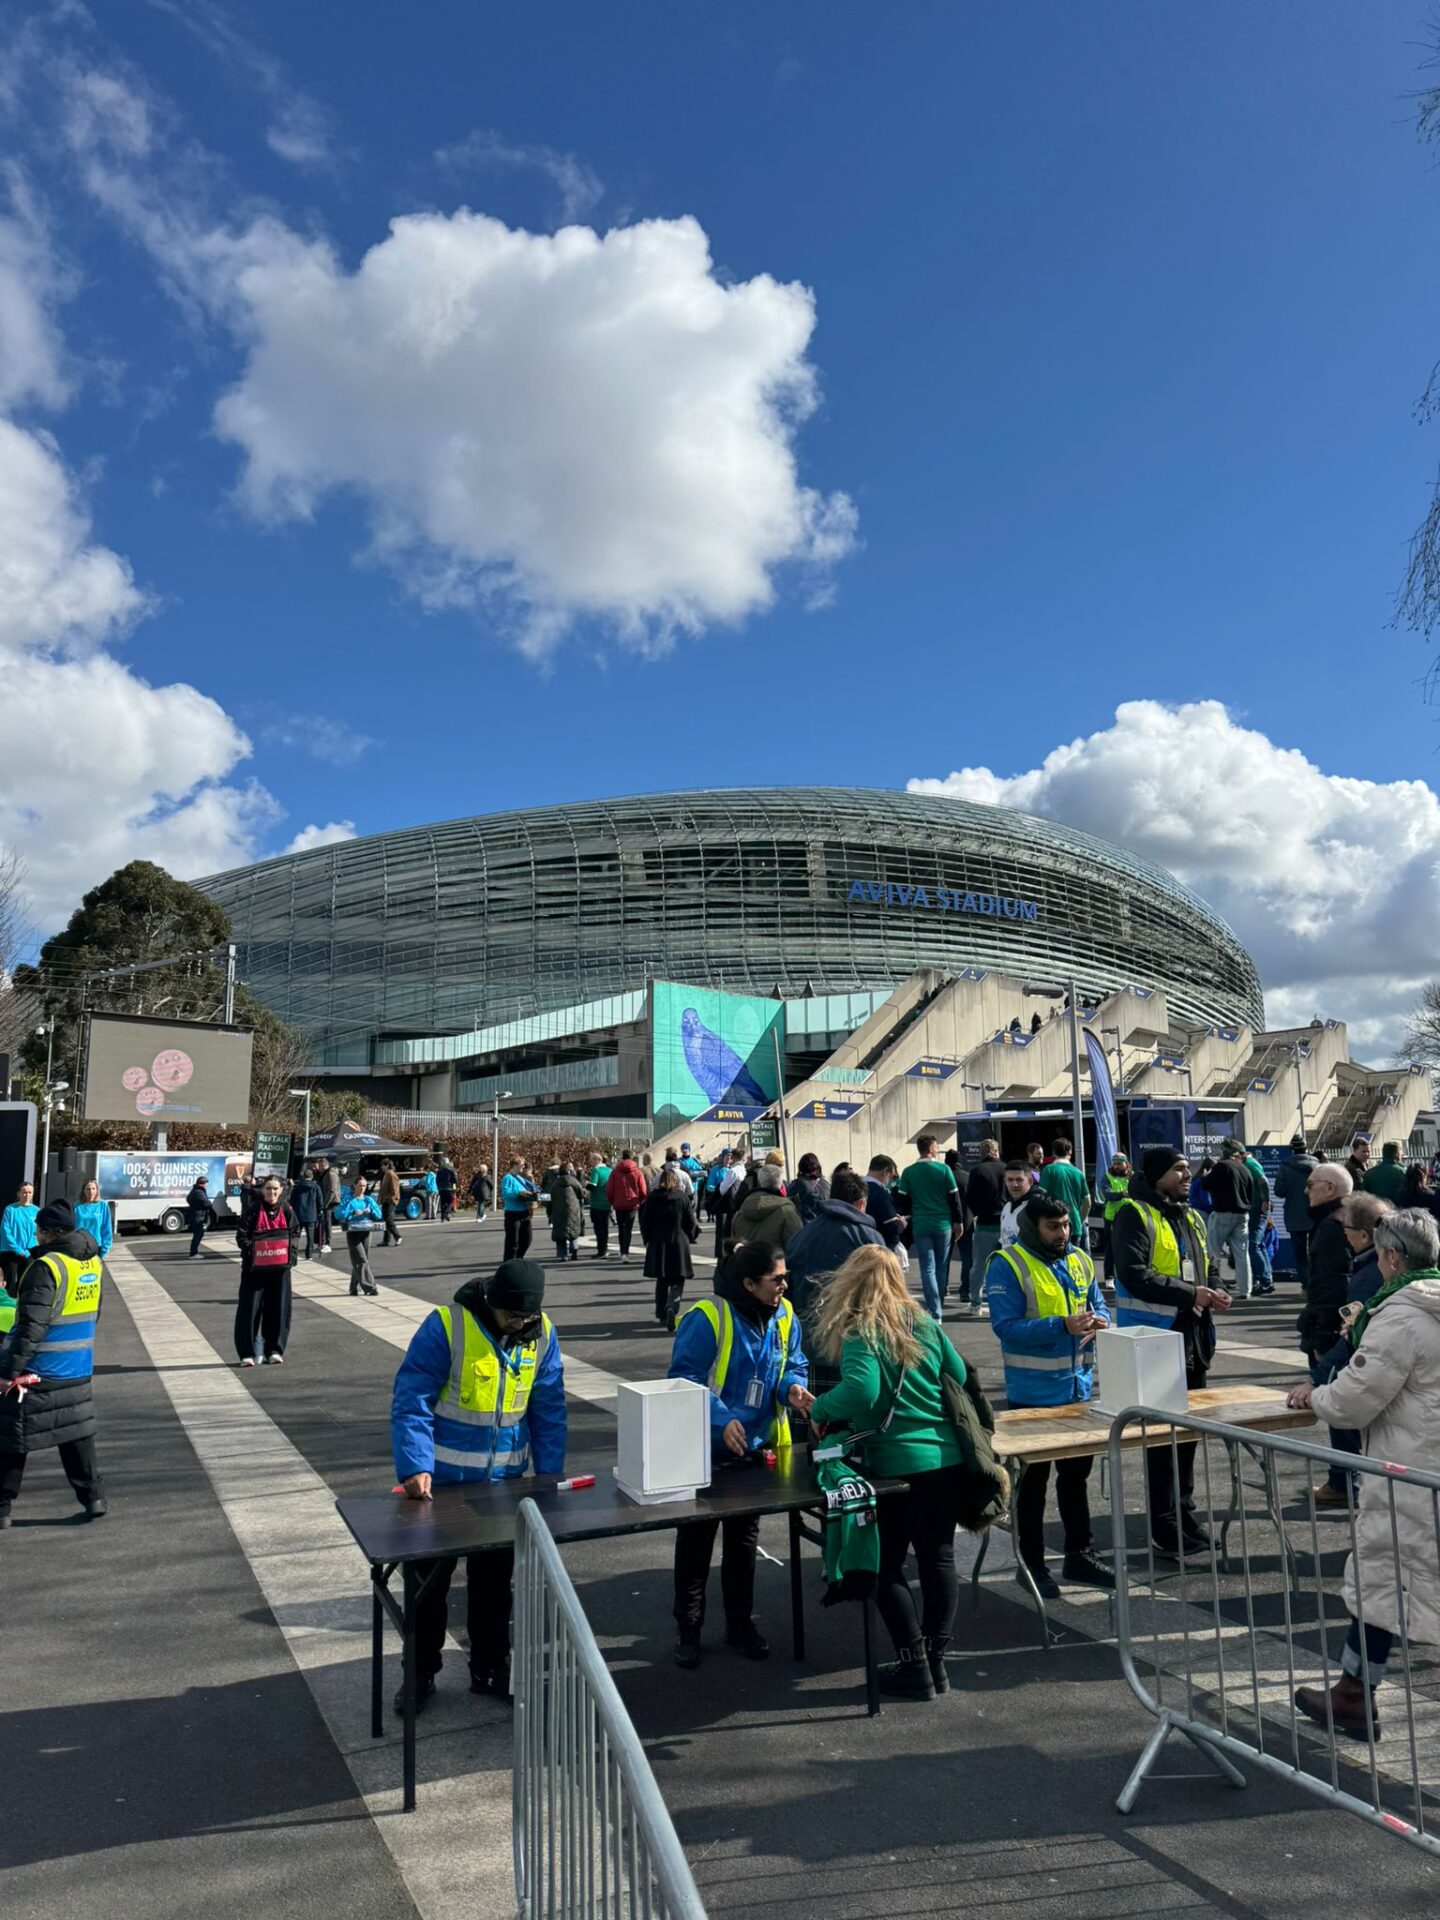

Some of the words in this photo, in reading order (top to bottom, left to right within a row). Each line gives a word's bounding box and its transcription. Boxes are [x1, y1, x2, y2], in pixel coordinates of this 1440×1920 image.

[848, 879, 930, 907] AVIVA
[936, 888, 1039, 921] STADIUM
[725, 1110, 744, 1119] AVIVA
[1184, 1135, 1225, 1144] NTERSPORT
[257, 1143, 284, 1151] RADIOS
[1189, 1144, 1212, 1154] Elvers
[256, 1151, 272, 1160] €13
[123, 1162, 151, 1175] 100%
[154, 1162, 209, 1174] GUINNESS
[130, 1176, 147, 1188] 0%
[256, 1247, 288, 1257] RADIOS
